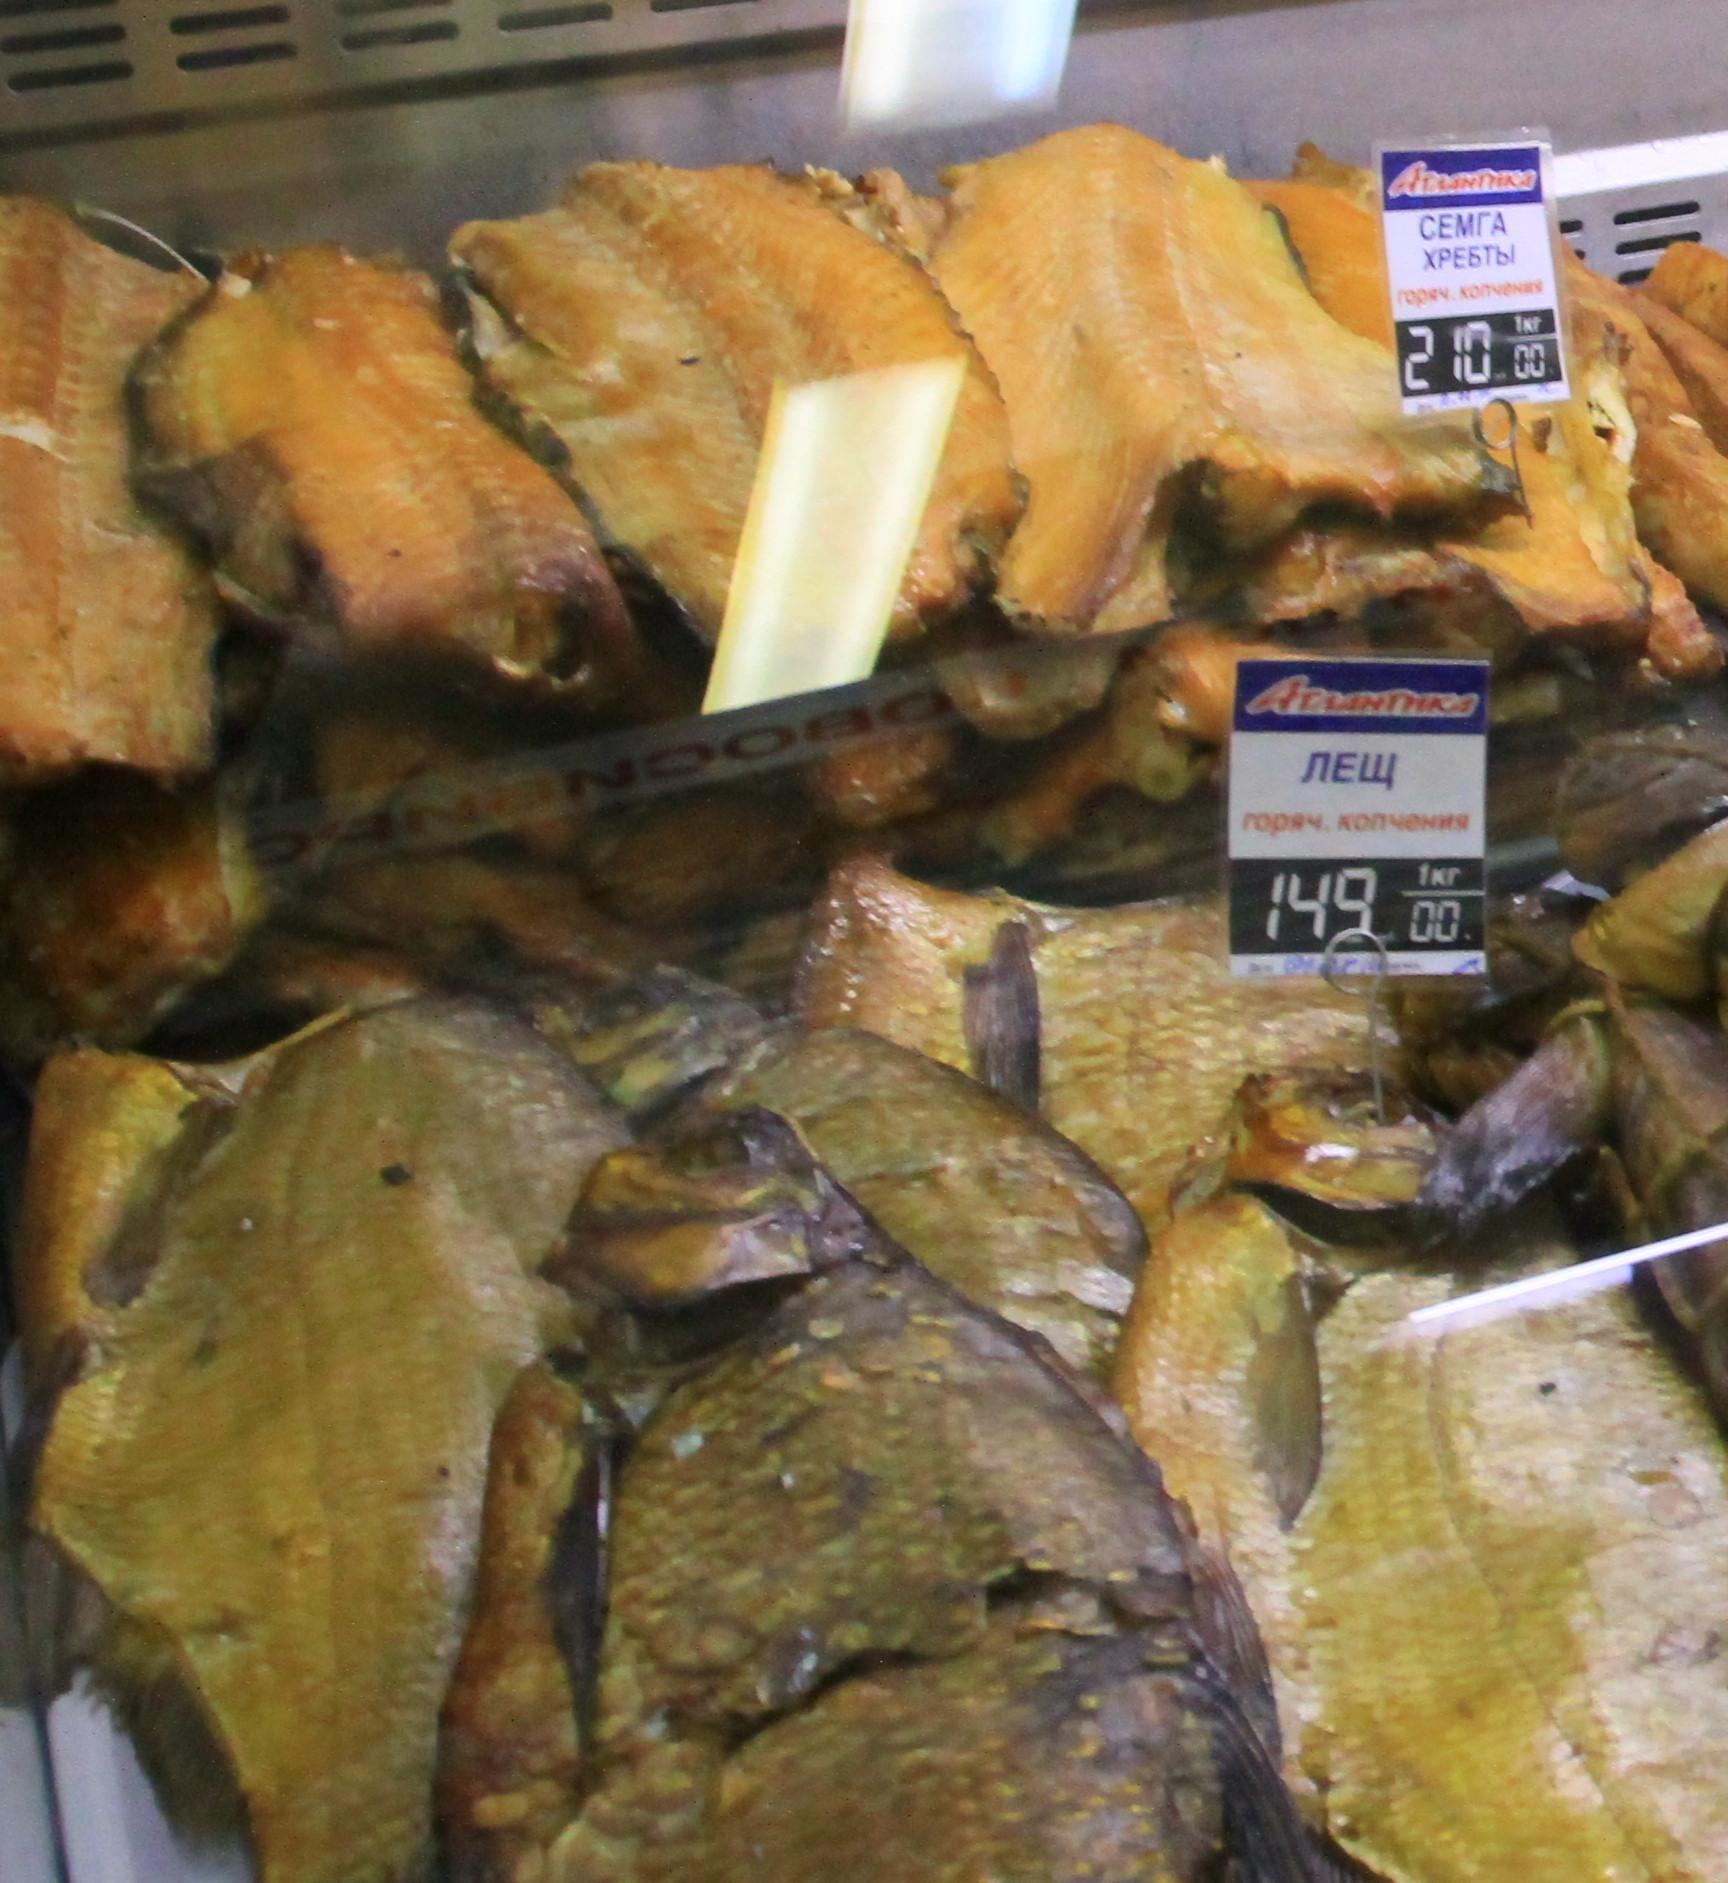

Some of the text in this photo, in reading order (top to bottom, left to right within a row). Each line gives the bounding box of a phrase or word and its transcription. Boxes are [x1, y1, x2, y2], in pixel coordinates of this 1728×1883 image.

[1420, 211, 1507, 241] СЕМГА
[1422, 244, 1515, 271] ХРЕБТЫ
[1513, 314, 1543, 334] 1кг
[1405, 319, 1491, 391] 210
[1513, 342, 1546, 380] 00
[1301, 752, 1398, 791] ЛЕЩ
[1337, 811, 1470, 834] копчения
[1418, 861, 1463, 888] 1кг
[1266, 867, 1378, 944] 149
[1408, 900, 1462, 944] 00
